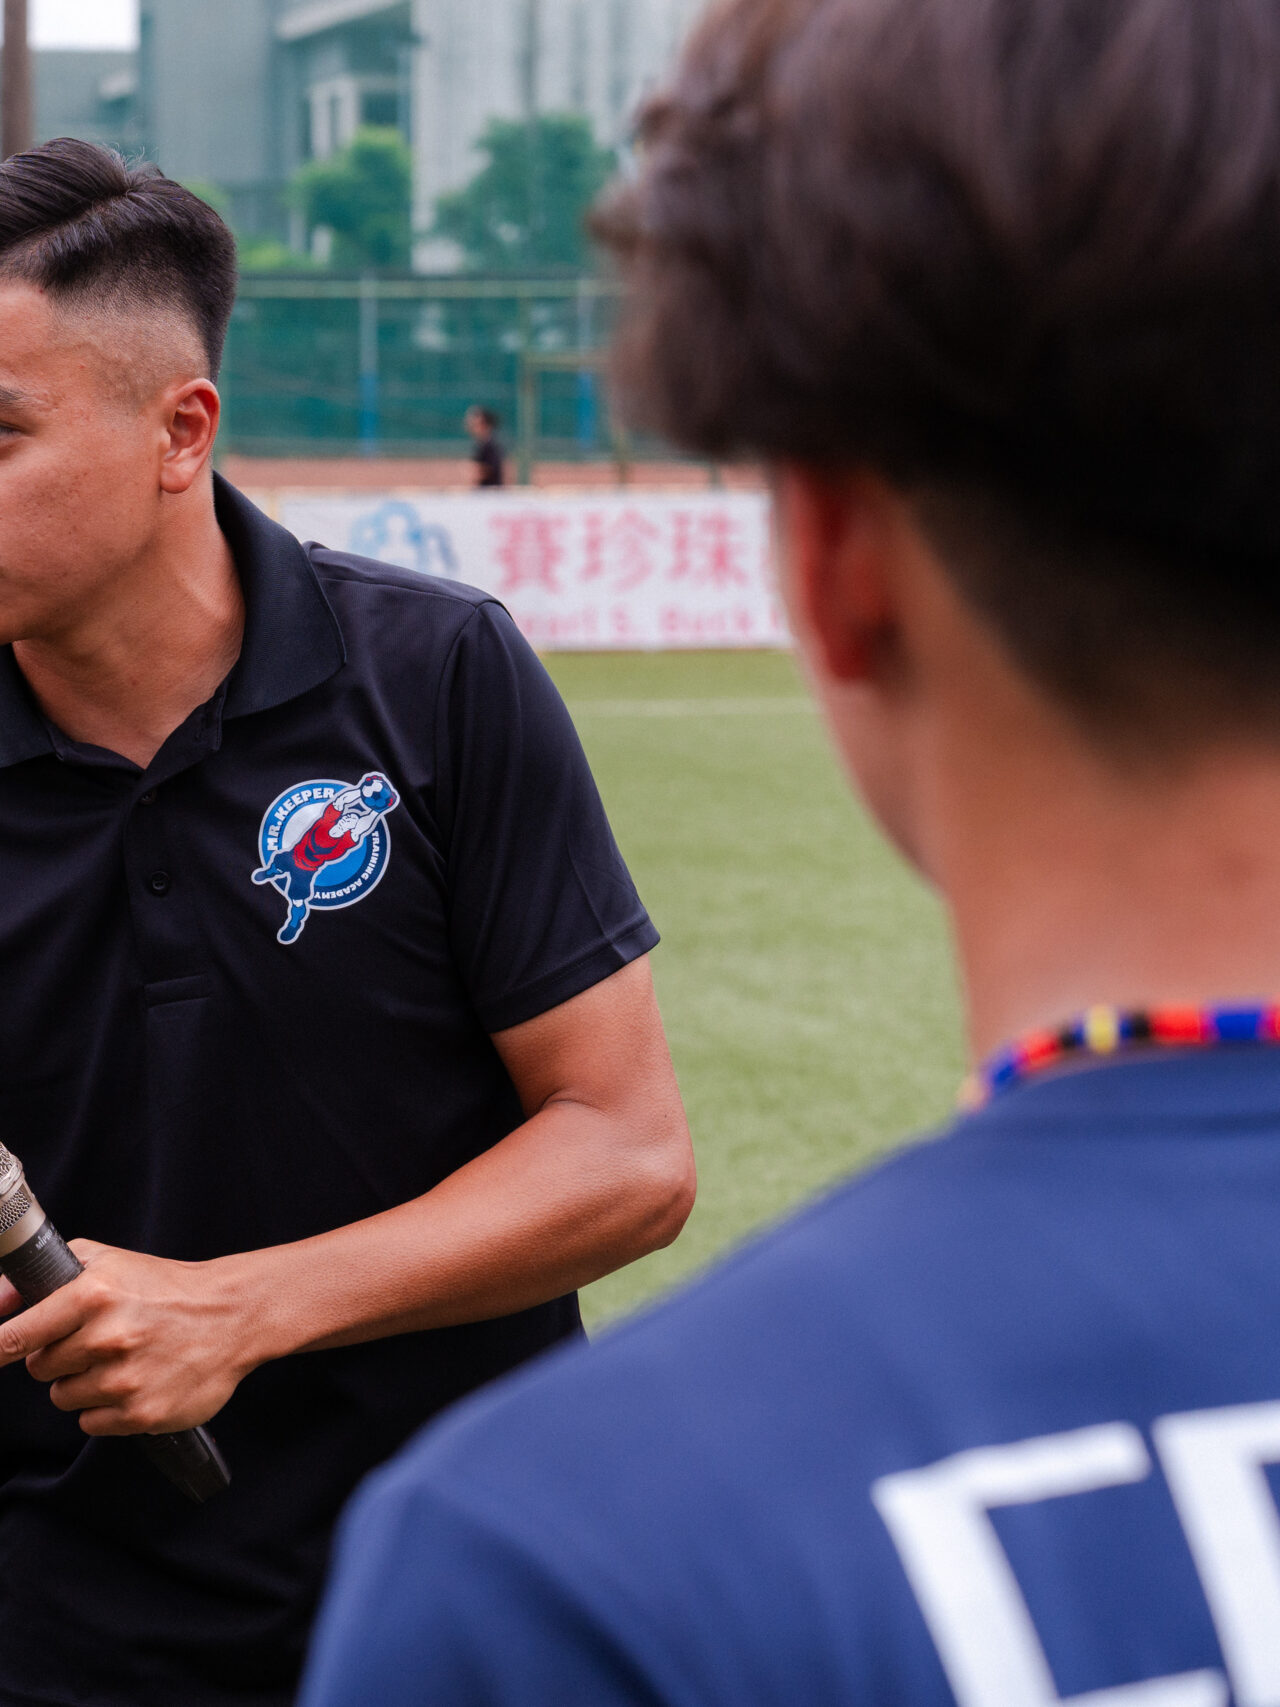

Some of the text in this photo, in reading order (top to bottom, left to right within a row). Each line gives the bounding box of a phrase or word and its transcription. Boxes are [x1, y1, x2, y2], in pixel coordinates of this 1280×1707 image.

[490, 506, 778, 594] 賽珍珠
[314, 830, 380, 899] TRAINING ACADEMY
